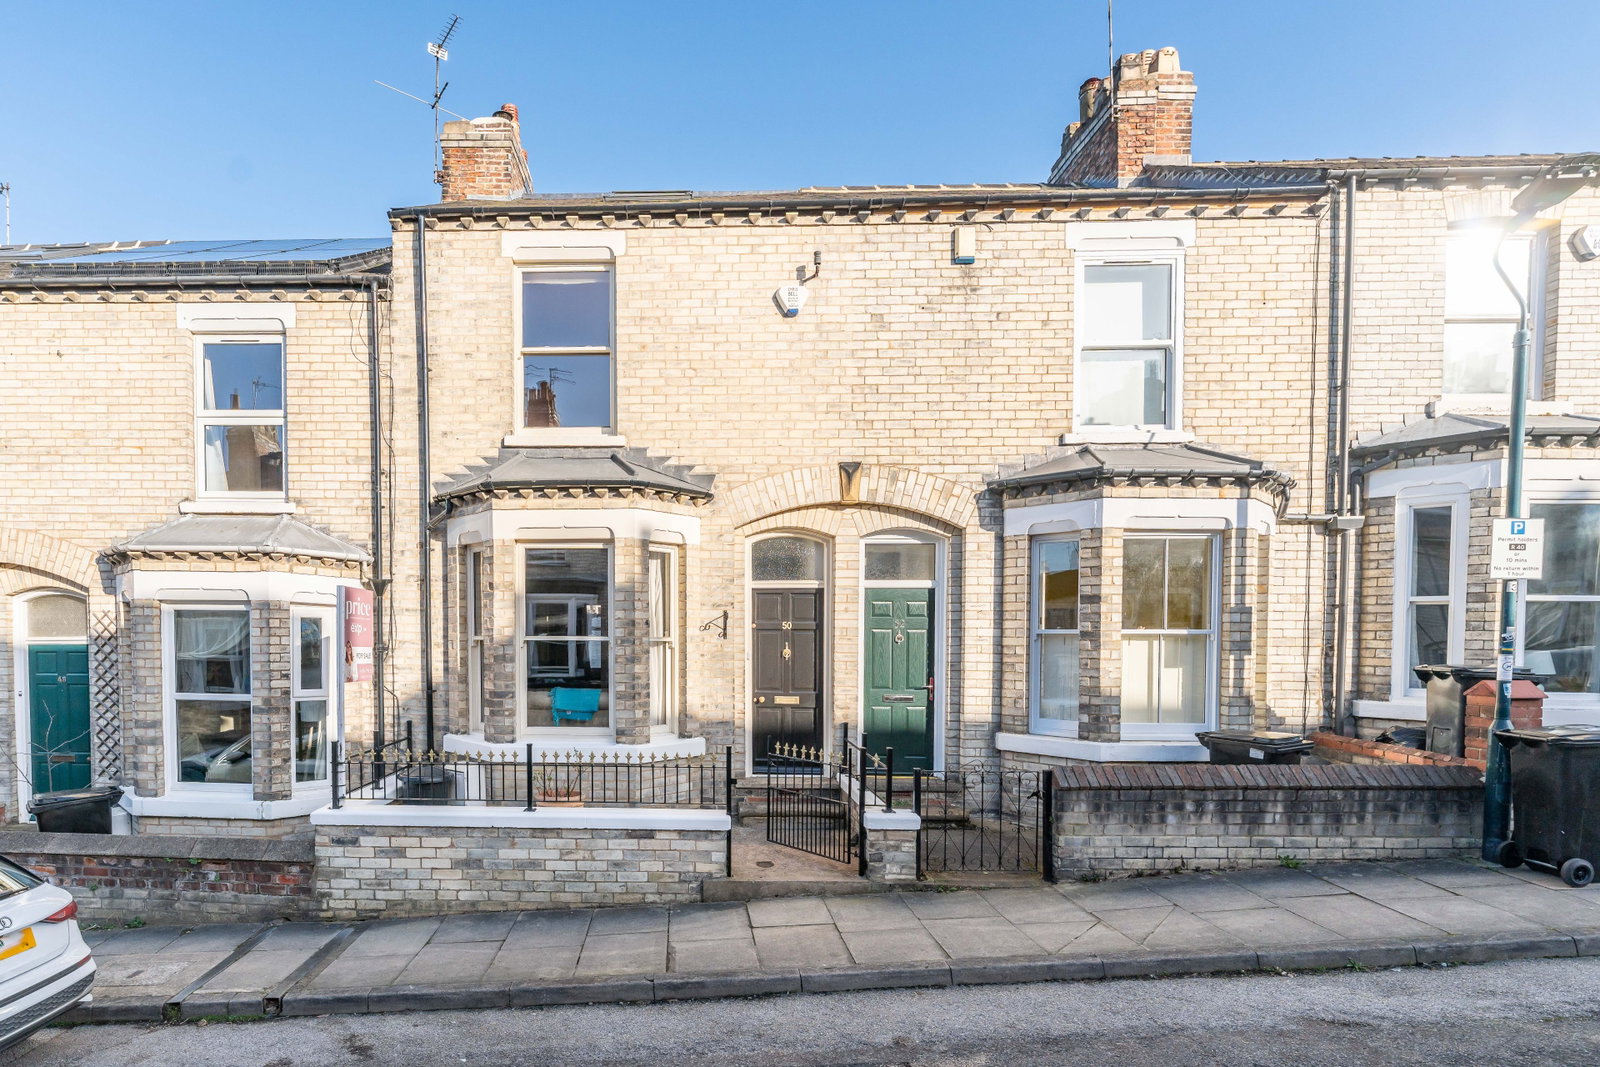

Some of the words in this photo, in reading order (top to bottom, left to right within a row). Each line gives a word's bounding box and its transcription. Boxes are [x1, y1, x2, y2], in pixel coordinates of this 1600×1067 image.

[1514, 522, 1524, 534] P
[346, 597, 370, 620] price
[782, 621, 792, 630] 50
